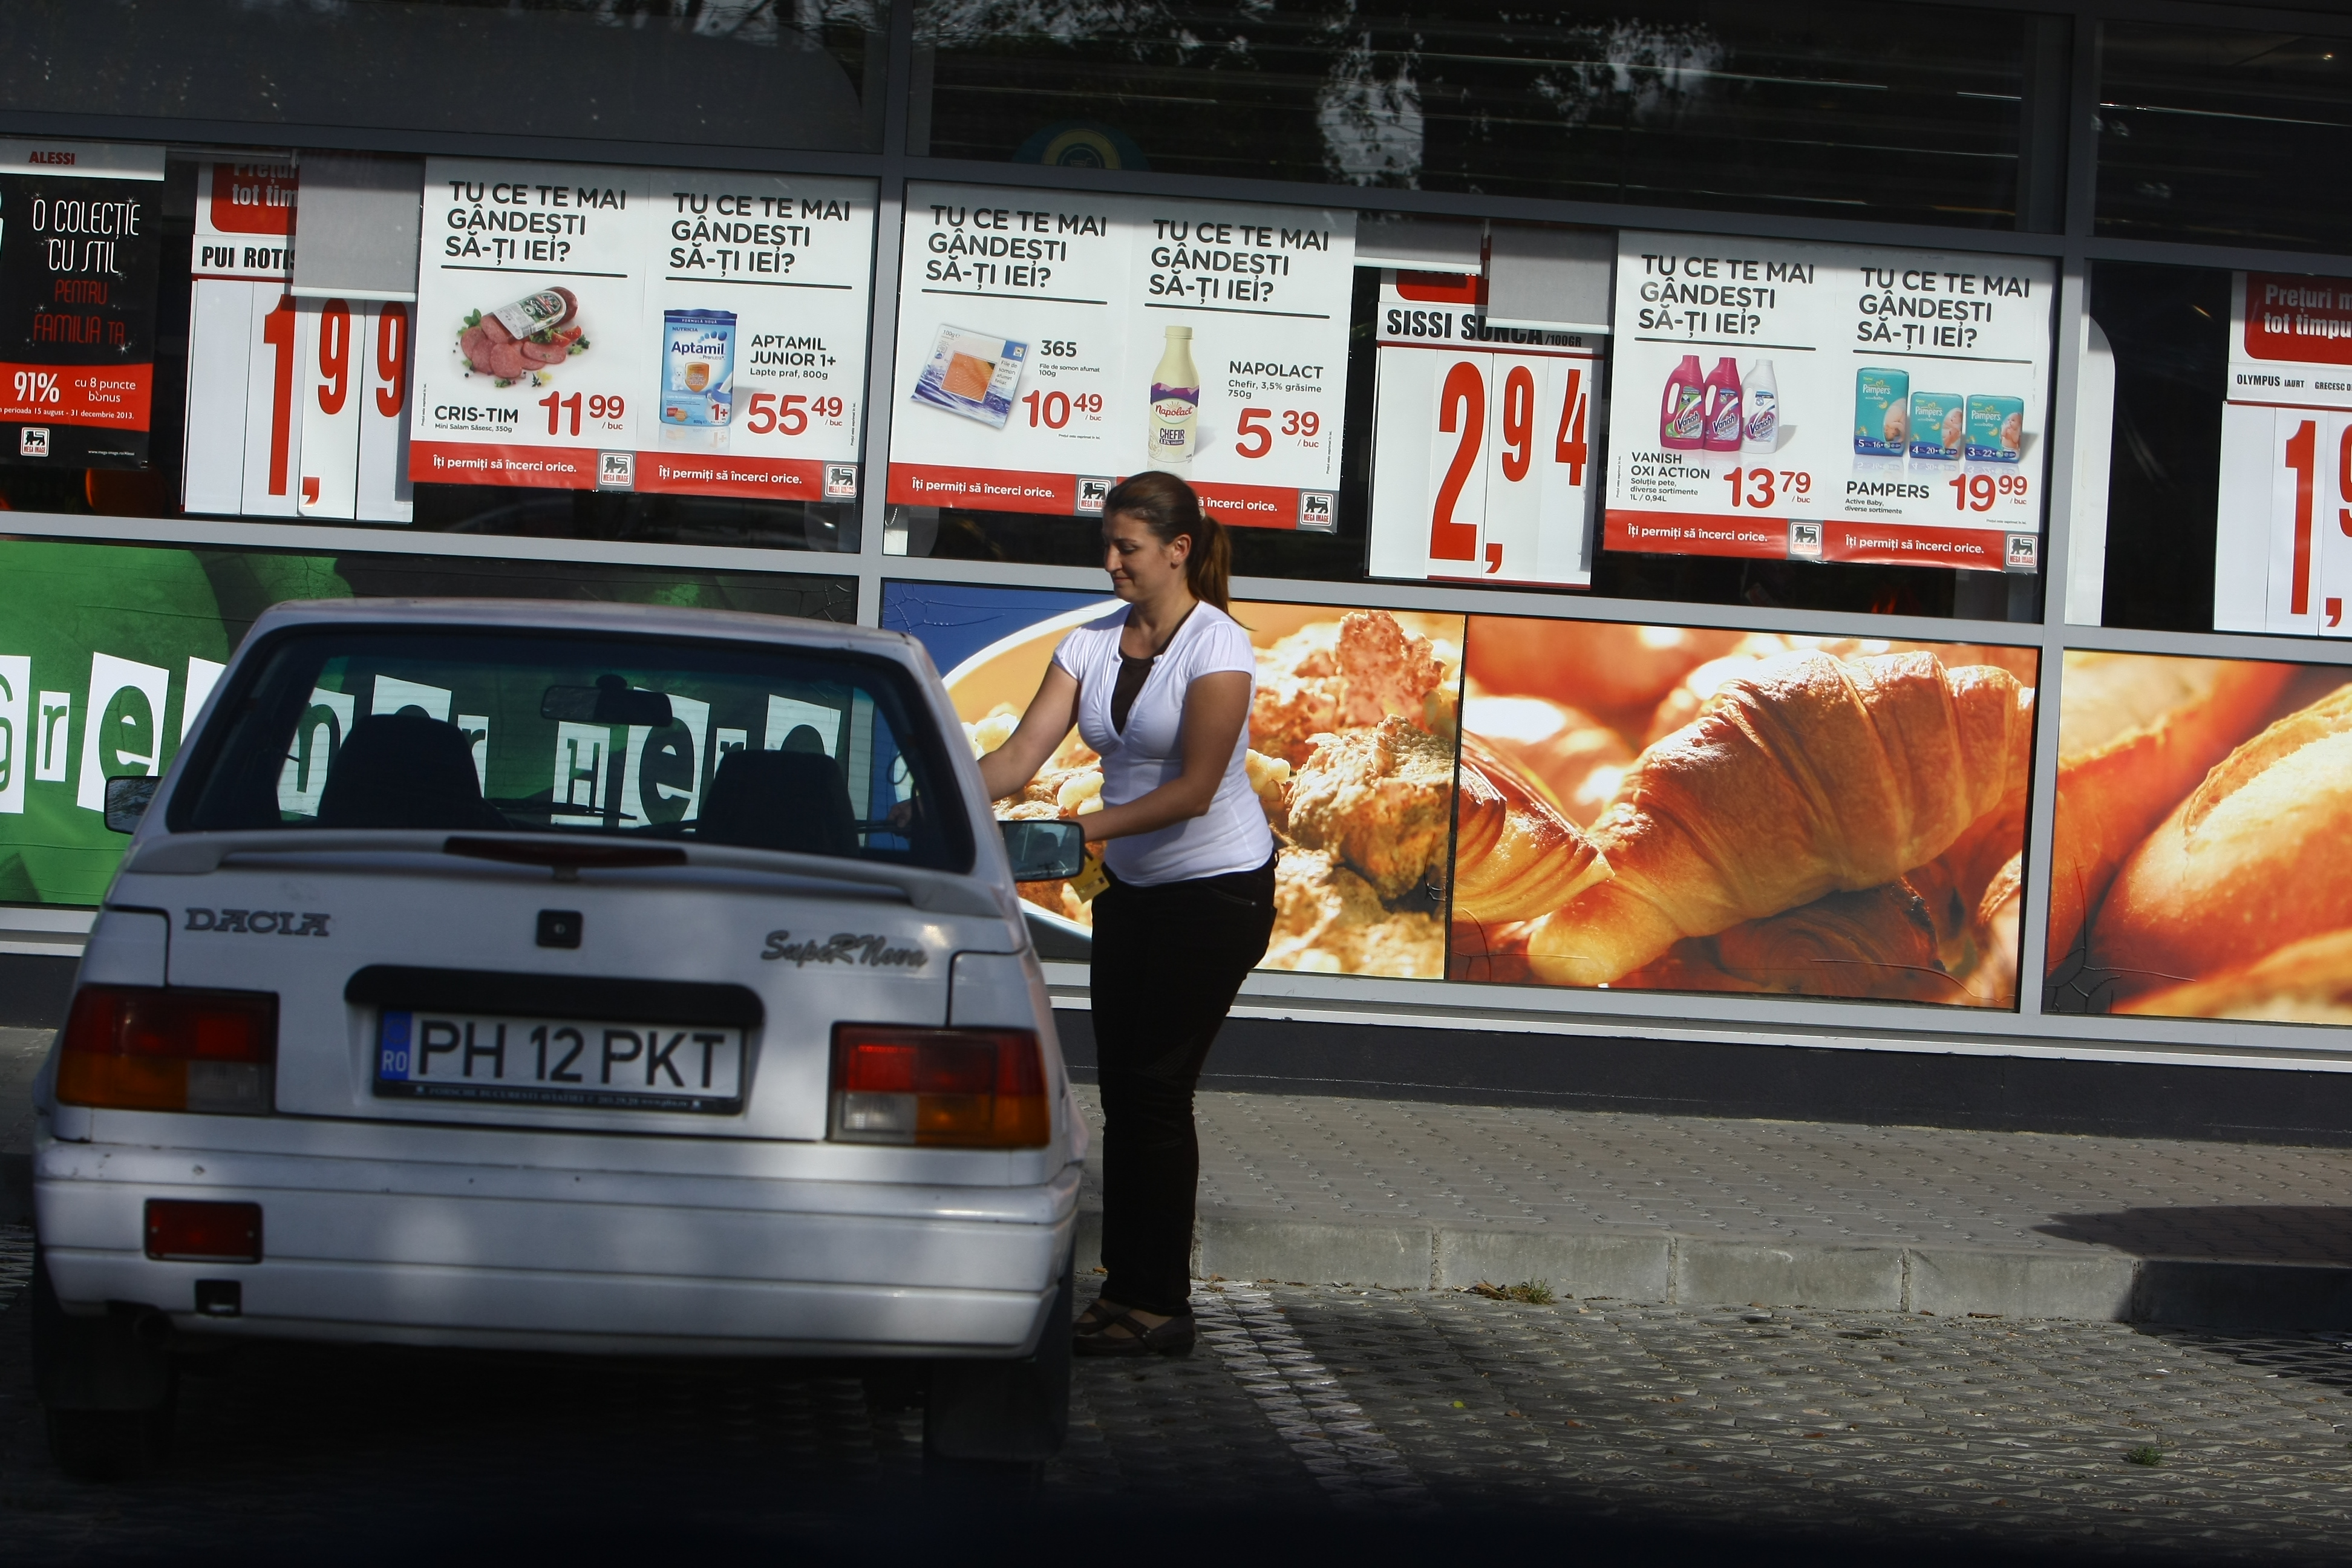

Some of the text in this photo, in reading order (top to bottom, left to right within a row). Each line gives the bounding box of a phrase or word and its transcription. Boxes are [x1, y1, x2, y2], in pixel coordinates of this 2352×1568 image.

[29, 151, 75, 165] ALESSI
[232, 184, 259, 206] tot
[449, 181, 626, 210] TU CE TE MAI
[33, 200, 140, 240] O COLECȚIE
[447, 203, 586, 240] GÂNDEȘTI
[1153, 219, 1328, 251] TU CE TE MAI
[49, 239, 119, 273] CU STIL
[201, 246, 235, 268] PUI
[445, 231, 571, 266] SĂ-ȚI IEI?
[1151, 243, 1289, 281] GÂNDEȘTI
[1641, 254, 1814, 284] TU CE TE MAI
[54, 279, 108, 304] PENTRU
[1149, 269, 1273, 304] SĂ-ȚI IEI?
[1640, 277, 1775, 314] GÂNDEȘTI
[2265, 284, 2331, 313] Prețuri
[33, 313, 125, 345] FAMILIA TA
[1387, 309, 1452, 338] SISSI
[1545, 335, 1581, 347] /100GR
[1638, 304, 1760, 338] SĂ-ȚI IEI?
[2264, 312, 2290, 335] tot
[671, 341, 724, 355] Aptamil
[751, 334, 826, 351] APTAMIL
[1040, 340, 1077, 358] 365
[750, 351, 836, 367] JUNIOR 1+
[750, 367, 828, 380] Lapte praf, 800g
[1229, 361, 1324, 379] NAPOLACT
[14, 371, 59, 403] 91%
[90, 377, 96, 388] 8
[100, 381, 136, 391] puncte
[1228, 379, 1322, 393] Chefir, 3,5% grăsime
[1863, 384, 1891, 396] Pampers
[2237, 374, 2345, 391] OLYMPUS IAURT GRECESC
[1228, 390, 1252, 399] 750g
[434, 406, 518, 423] CRIS-TIM
[538, 391, 624, 436] 11 99
[711, 403, 728, 420] 1+
[748, 393, 842, 436] 55 49
[1022, 390, 1103, 430] 10 49
[1155, 405, 1194, 417] Napolact
[1915, 406, 1942, 418] Pampers
[1971, 410, 2001, 422] Pampers
[1677, 412, 1698, 430] Vanish
[1713, 416, 1735, 432] Vanish
[1749, 416, 1771, 434] Vanish
[1160, 428, 1184, 439] CHEFIR
[1235, 407, 1319, 459] 5 39
[1303, 439, 1319, 448] buc
[1968, 448, 1975, 456] 3
[433, 454, 577, 472] Îți permiți să încerci orice.
[1632, 452, 1682, 464] VANISH
[1631, 465, 1710, 479] OXI ACTION
[1631, 478, 1656, 486] Soluție
[1723, 466, 1811, 508] 13 79
[1846, 481, 1930, 499] PAMPERS
[1949, 474, 2027, 511] 19 99
[1207, 497, 1277, 512] încerci orice.
[1627, 523, 1768, 542] Îți permiți să încerci orice.
[185, 907, 331, 936] DACIA
[382, 1050, 408, 1073] RO
[419, 1019, 725, 1089] PH 12 PKT
